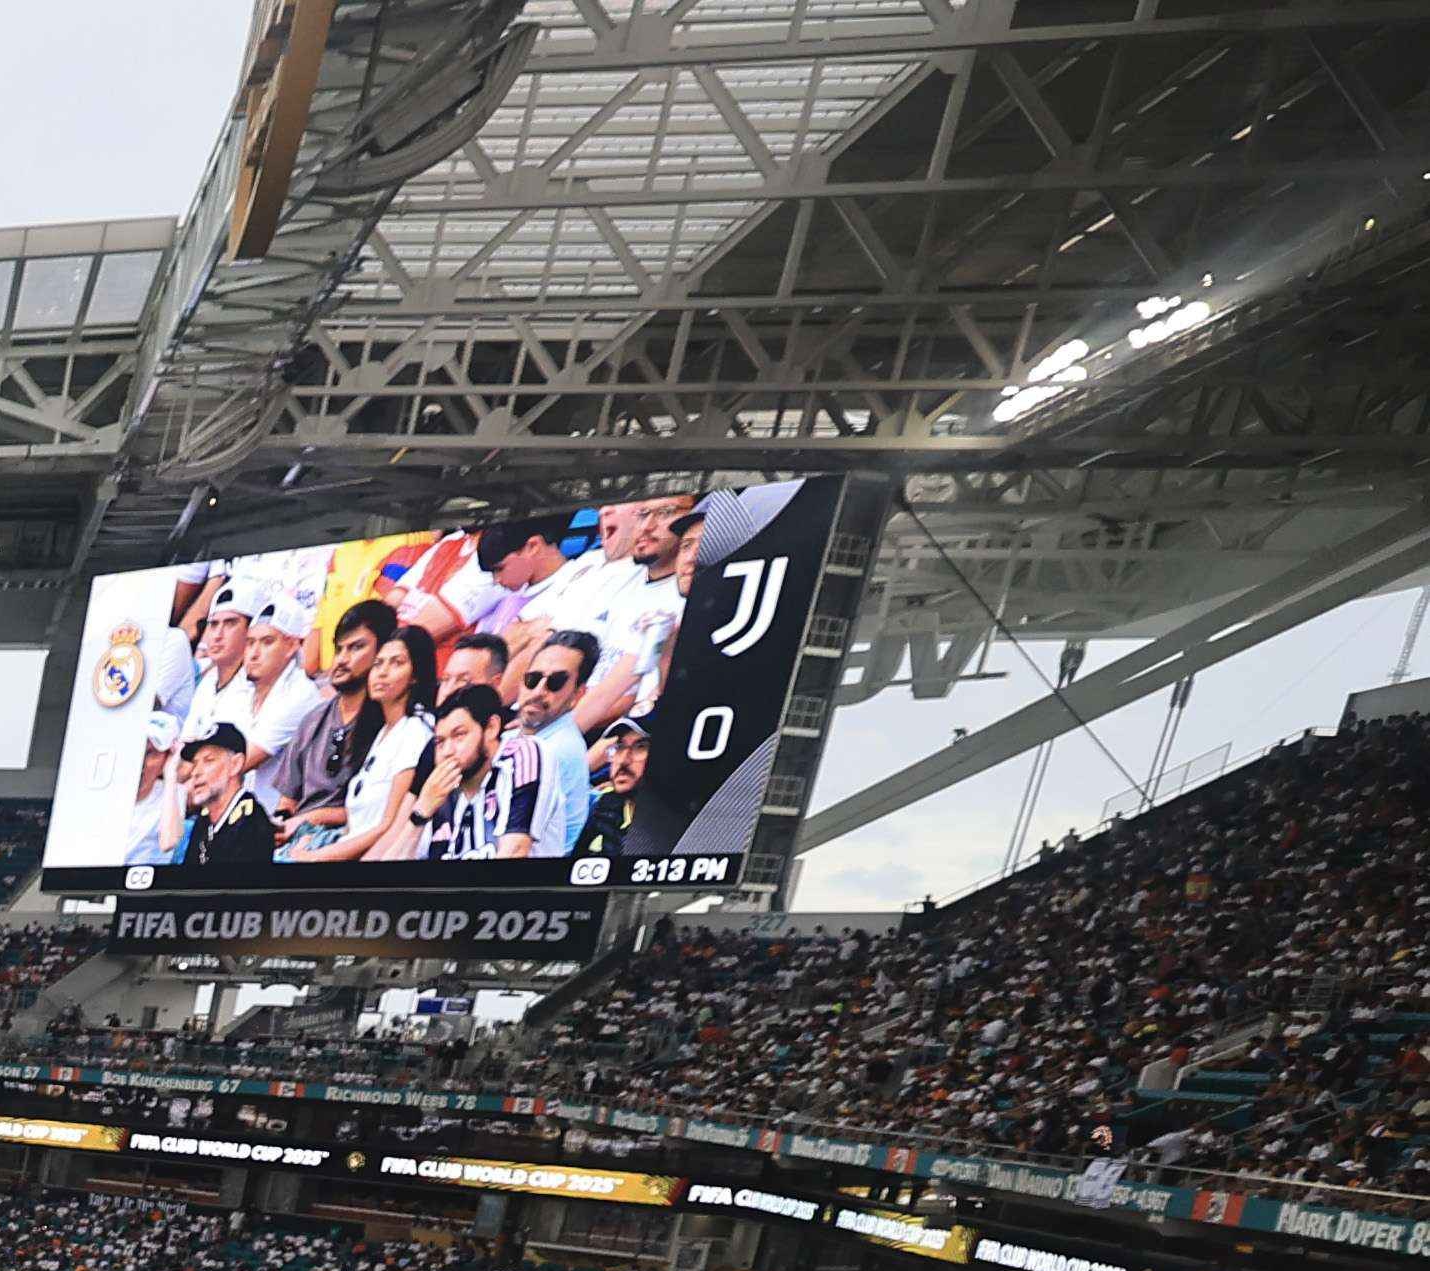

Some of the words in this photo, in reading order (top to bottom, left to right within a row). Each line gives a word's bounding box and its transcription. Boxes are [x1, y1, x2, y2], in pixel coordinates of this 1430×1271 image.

[687, 707, 735, 760] 0
[630, 858, 687, 883] 3:13
[689, 858, 729, 882] PM
[117, 911, 177, 939] FIFA
[183, 911, 263, 939] CLUB
[269, 910, 392, 939] WORLD
[397, 909, 463, 941] CUP
[218, 1079, 240, 1094] 67
[325, 1086, 402, 1106] RICHMOND
[455, 1095, 477, 1110] 78
[1275, 1199, 1332, 1240] MARK
[1334, 1209, 1408, 1252] DUPER
